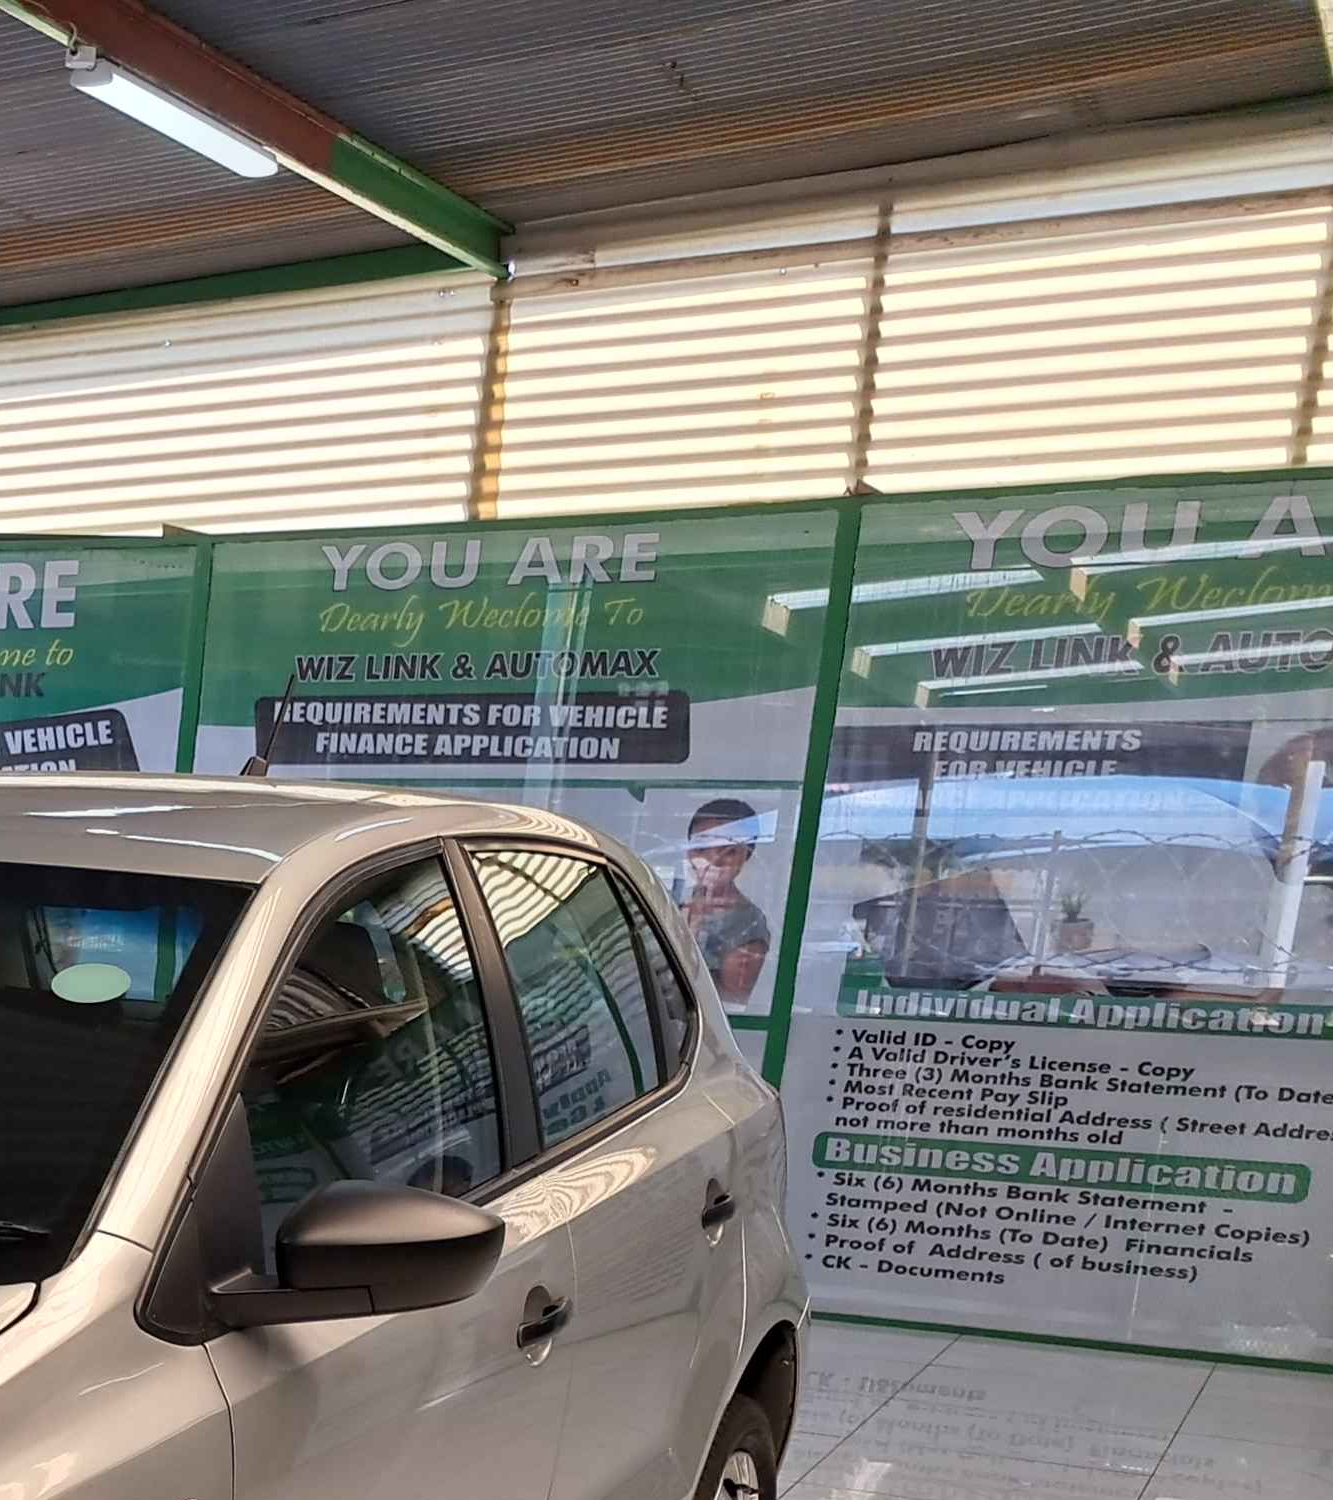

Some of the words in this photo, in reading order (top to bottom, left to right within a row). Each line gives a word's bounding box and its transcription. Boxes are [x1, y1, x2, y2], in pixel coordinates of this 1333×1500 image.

[952, 500, 1205, 569] YOU
[321, 538, 483, 592] YOU
[507, 532, 661, 585] ARE
[319, 594, 426, 648] Dearly
[440, 593, 591, 632] Weclome
[605, 597, 644, 627] To
[45, 639, 75, 668] to
[295, 653, 357, 682] WIZ
[364, 652, 443, 681] LINK
[450, 652, 476, 681] &
[485, 646, 661, 681] AUTOMAX
[933, 643, 1020, 680] WIZ
[1030, 634, 1144, 676] LINK
[1152, 631, 1184, 674] &
[273, 701, 482, 727] REQUIREMENTS
[487, 703, 541, 727] FOR
[549, 704, 669, 729] VEHICLE
[4, 720, 114, 755] VEHICLE
[316, 732, 429, 757] FINANCE
[433, 733, 621, 760] APPLICATION
[912, 729, 1142, 753] REQUIREMENTS
[933, 758, 989, 778] FOR
[995, 758, 1118, 778] VEHICLE
[855, 989, 1061, 1023] Individual
[1069, 998, 1324, 1035] Application
[852, 1029, 906, 1045] Valid
[914, 1033, 936, 1046] ID
[962, 1035, 1016, 1053] Copy
[847, 1063, 906, 1080] Three
[914, 1067, 943, 1084] (3)
[951, 1072, 1031, 1087] Months
[1039, 1074, 1098, 1091] Bank
[1106, 1078, 1226, 1099] Statement
[1235, 1085, 1268, 1102] (To
[848, 1047, 863, 1060] A
[873, 1047, 925, 1063] Valid
[1029, 1056, 1111, 1074] License
[1138, 1061, 1194, 1081] Copy
[843, 1080, 894, 1095] Most
[902, 1083, 973, 1100] Recent
[981, 1087, 1020, 1107] Pay
[1027, 1091, 1068, 1109] Slip
[835, 1115, 869, 1128] not
[876, 1118, 931, 1132] more
[939, 1120, 989, 1137] than
[996, 1123, 1079, 1142] months
[1087, 1130, 1123, 1145] old
[842, 1097, 899, 1112] Proof
[905, 1101, 926, 1115] of
[933, 1104, 1051, 1123] residential
[1058, 1110, 1152, 1129] Address
[1176, 1117, 1245, 1136] Street
[1254, 1122, 1333, 1142] Addre
[824, 1137, 1020, 1175] Business
[1029, 1151, 1296, 1196] Application
[833, 1172, 866, 1188] Six
[874, 1175, 903, 1193] (6)
[911, 1179, 997, 1198] Months
[1006, 1185, 1069, 1203] Bank
[1077, 1191, 1207, 1213] Statement
[826, 1192, 927, 1214] Stamped
[936, 1201, 986, 1219] (Not
[995, 1206, 1076, 1226] Online
[1084, 1213, 1097, 1229] /
[1104, 1215, 1205, 1237] Internet
[1214, 1224, 1310, 1247] Copies)
[827, 1213, 859, 1229] Six
[867, 1217, 896, 1235] (6)
[904, 1220, 991, 1241] Months
[999, 1228, 1032, 1245] (To
[1042, 1232, 1109, 1253] Date)
[1125, 1238, 1253, 1263] Financials
[822, 1255, 853, 1270] CK
[877, 1260, 1005, 1285] Documents
[825, 1234, 885, 1252] Proof
[893, 1240, 914, 1255] of
[929, 1243, 1025, 1265] Address
[1049, 1254, 1074, 1269] of
[1081, 1256, 1198, 1283] business)
